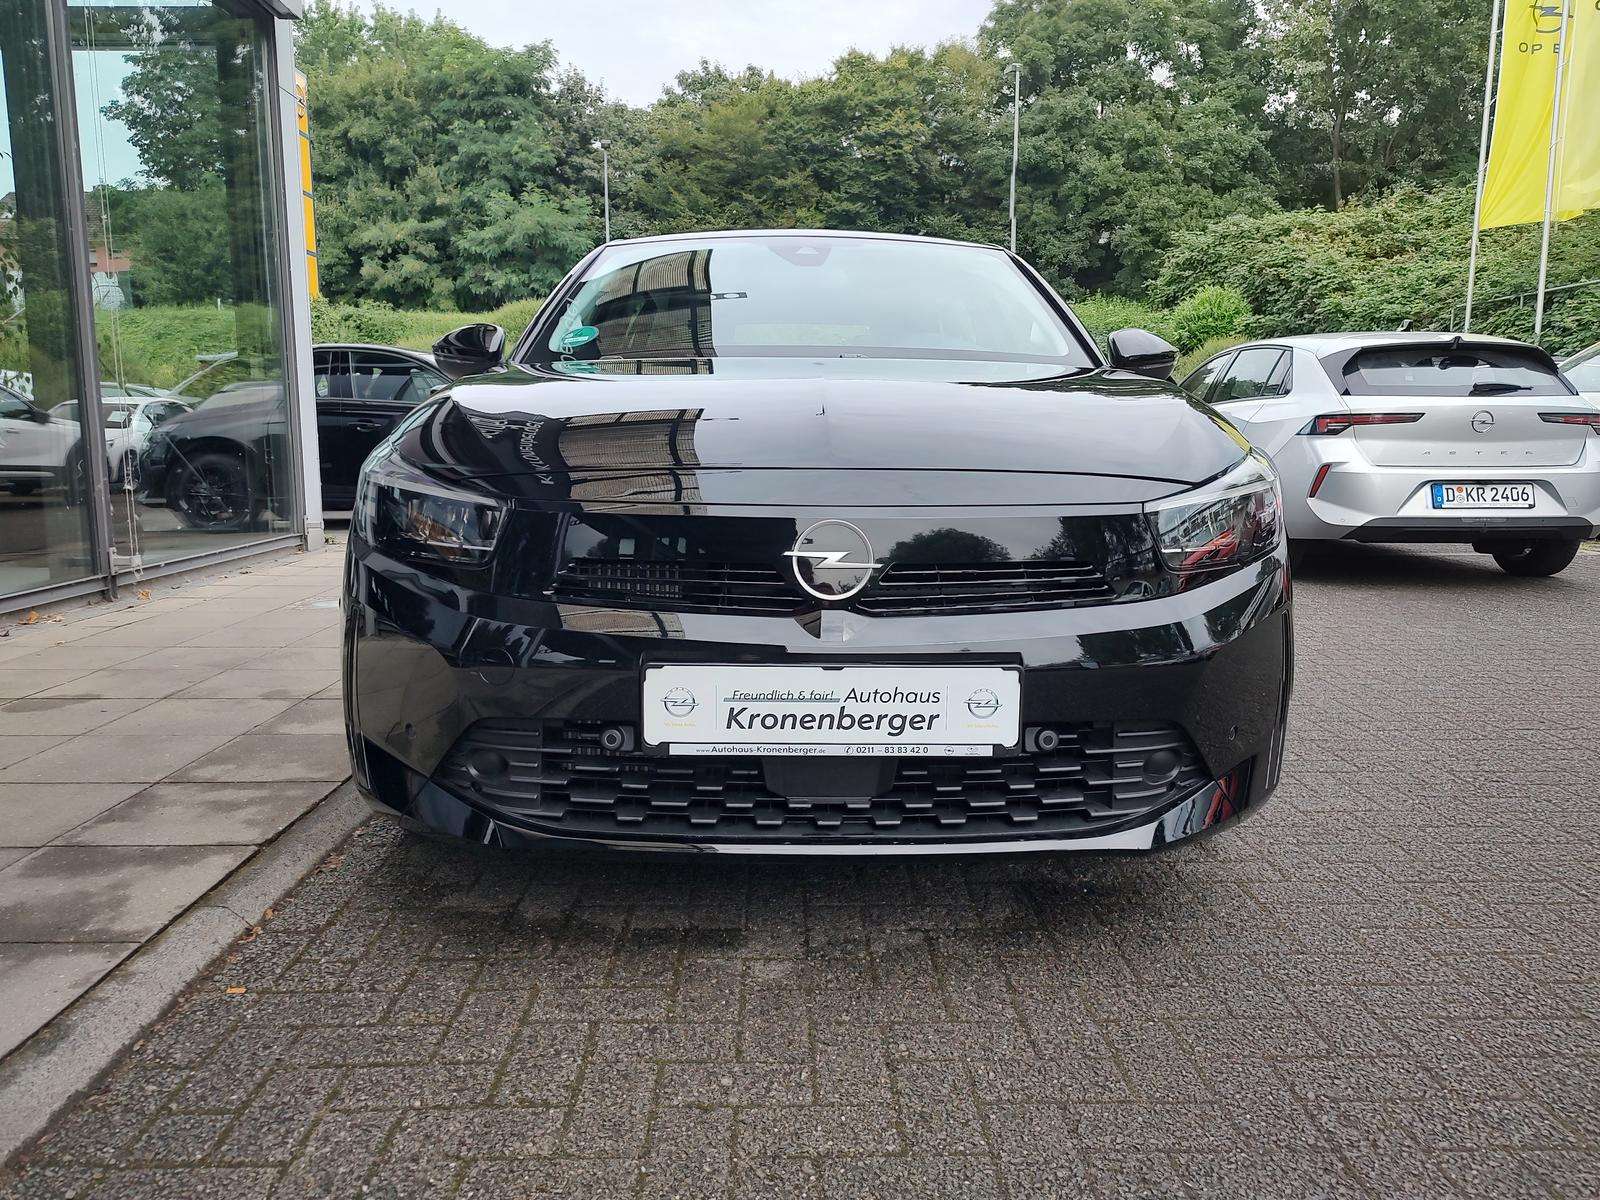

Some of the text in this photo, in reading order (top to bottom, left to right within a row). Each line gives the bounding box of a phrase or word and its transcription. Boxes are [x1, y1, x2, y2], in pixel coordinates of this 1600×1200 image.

[1518, 42, 1561, 55] OPE
[1445, 486, 1530, 503] D KR 2406
[732, 686, 941, 703] Freundlich & fair! Autohaus
[725, 705, 941, 737] Kronenberger
[856, 746, 874, 754] 0211
[884, 746, 895, 754] 83
[897, 746, 908, 754] 83
[910, 746, 921, 754] 42
